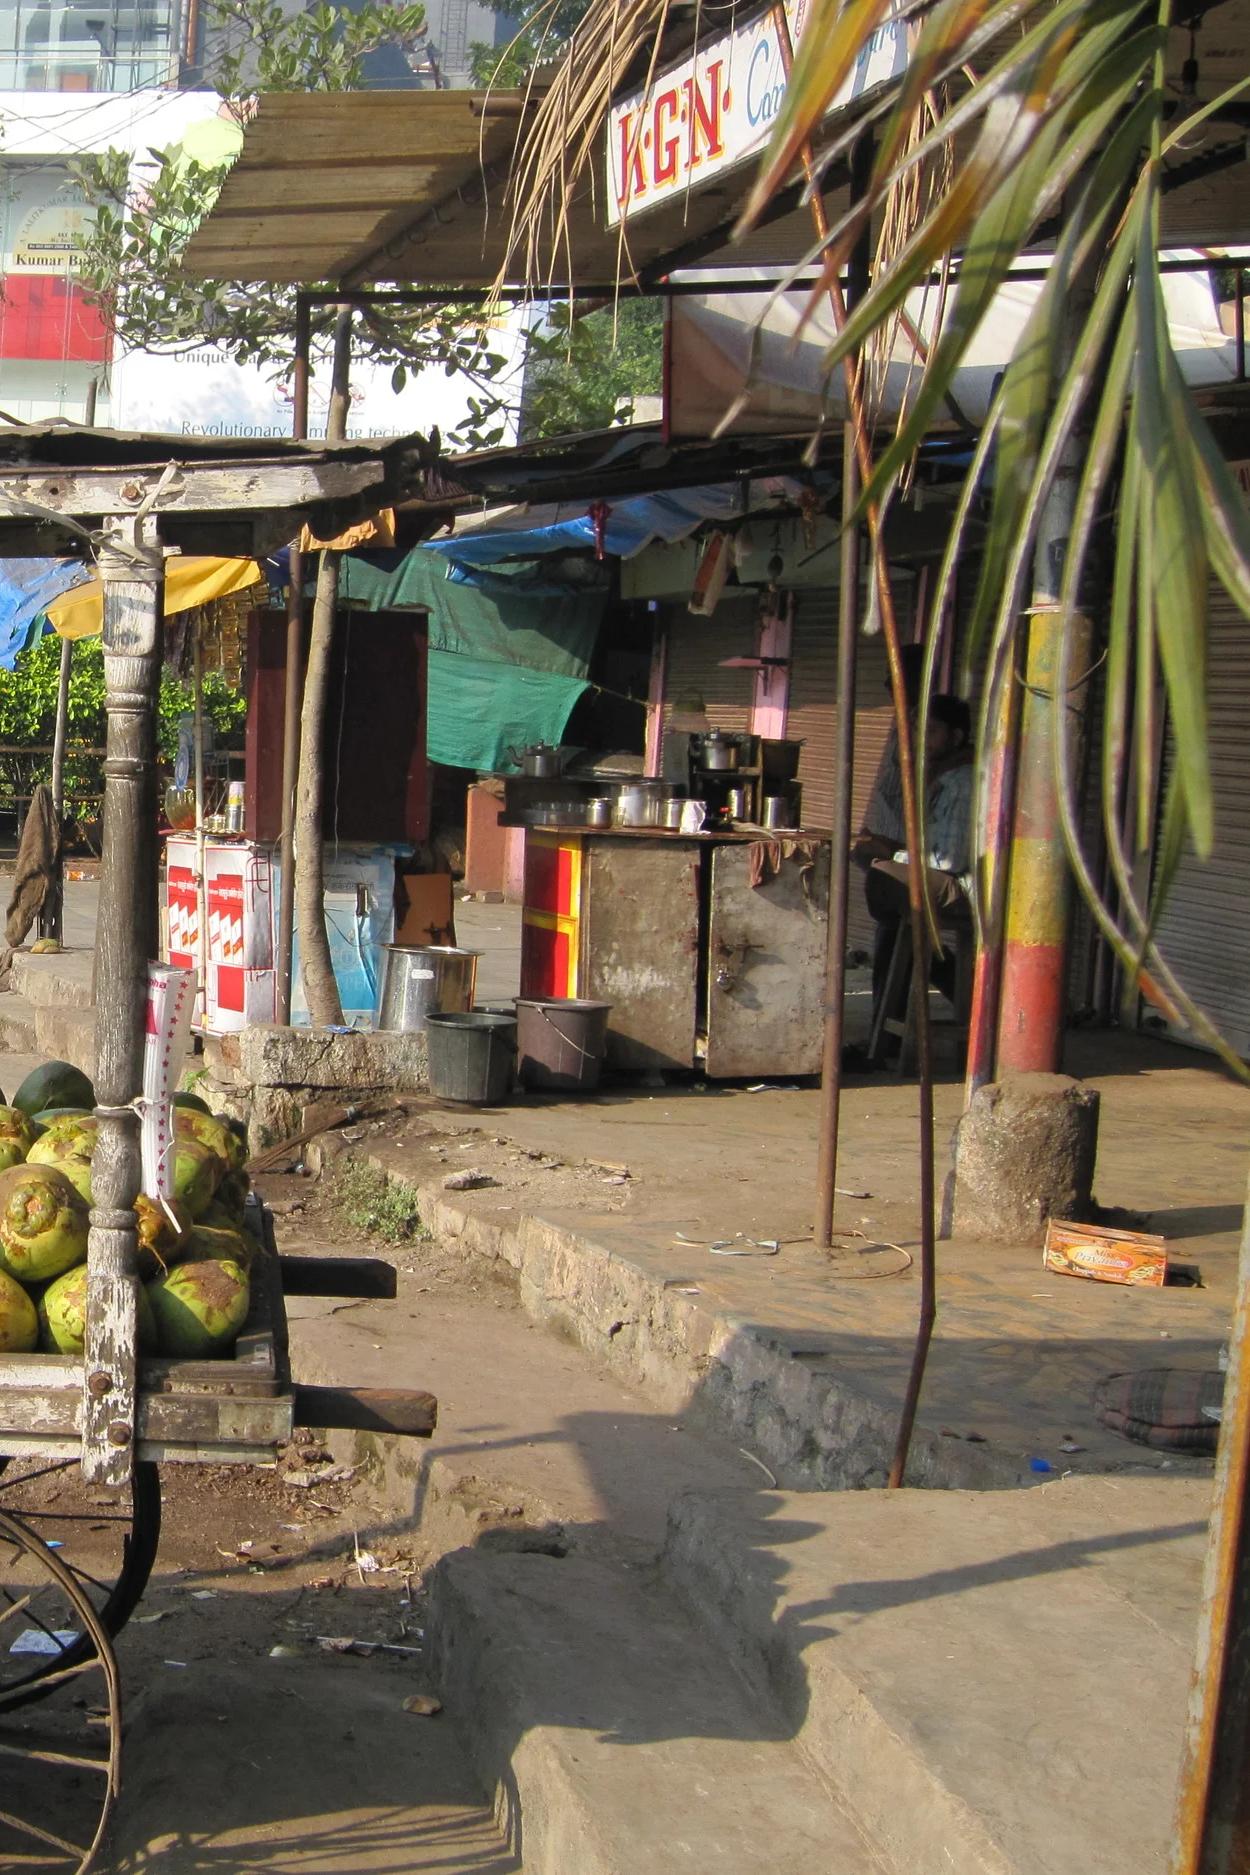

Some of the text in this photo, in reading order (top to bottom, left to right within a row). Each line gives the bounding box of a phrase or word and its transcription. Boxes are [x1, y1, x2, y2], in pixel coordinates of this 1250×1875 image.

[16, 253, 65, 266] Kumar
[174, 349, 230, 368] Unique
[181, 421, 287, 439] Revolutionary
[1095, 1248, 1115, 1258] Miss
